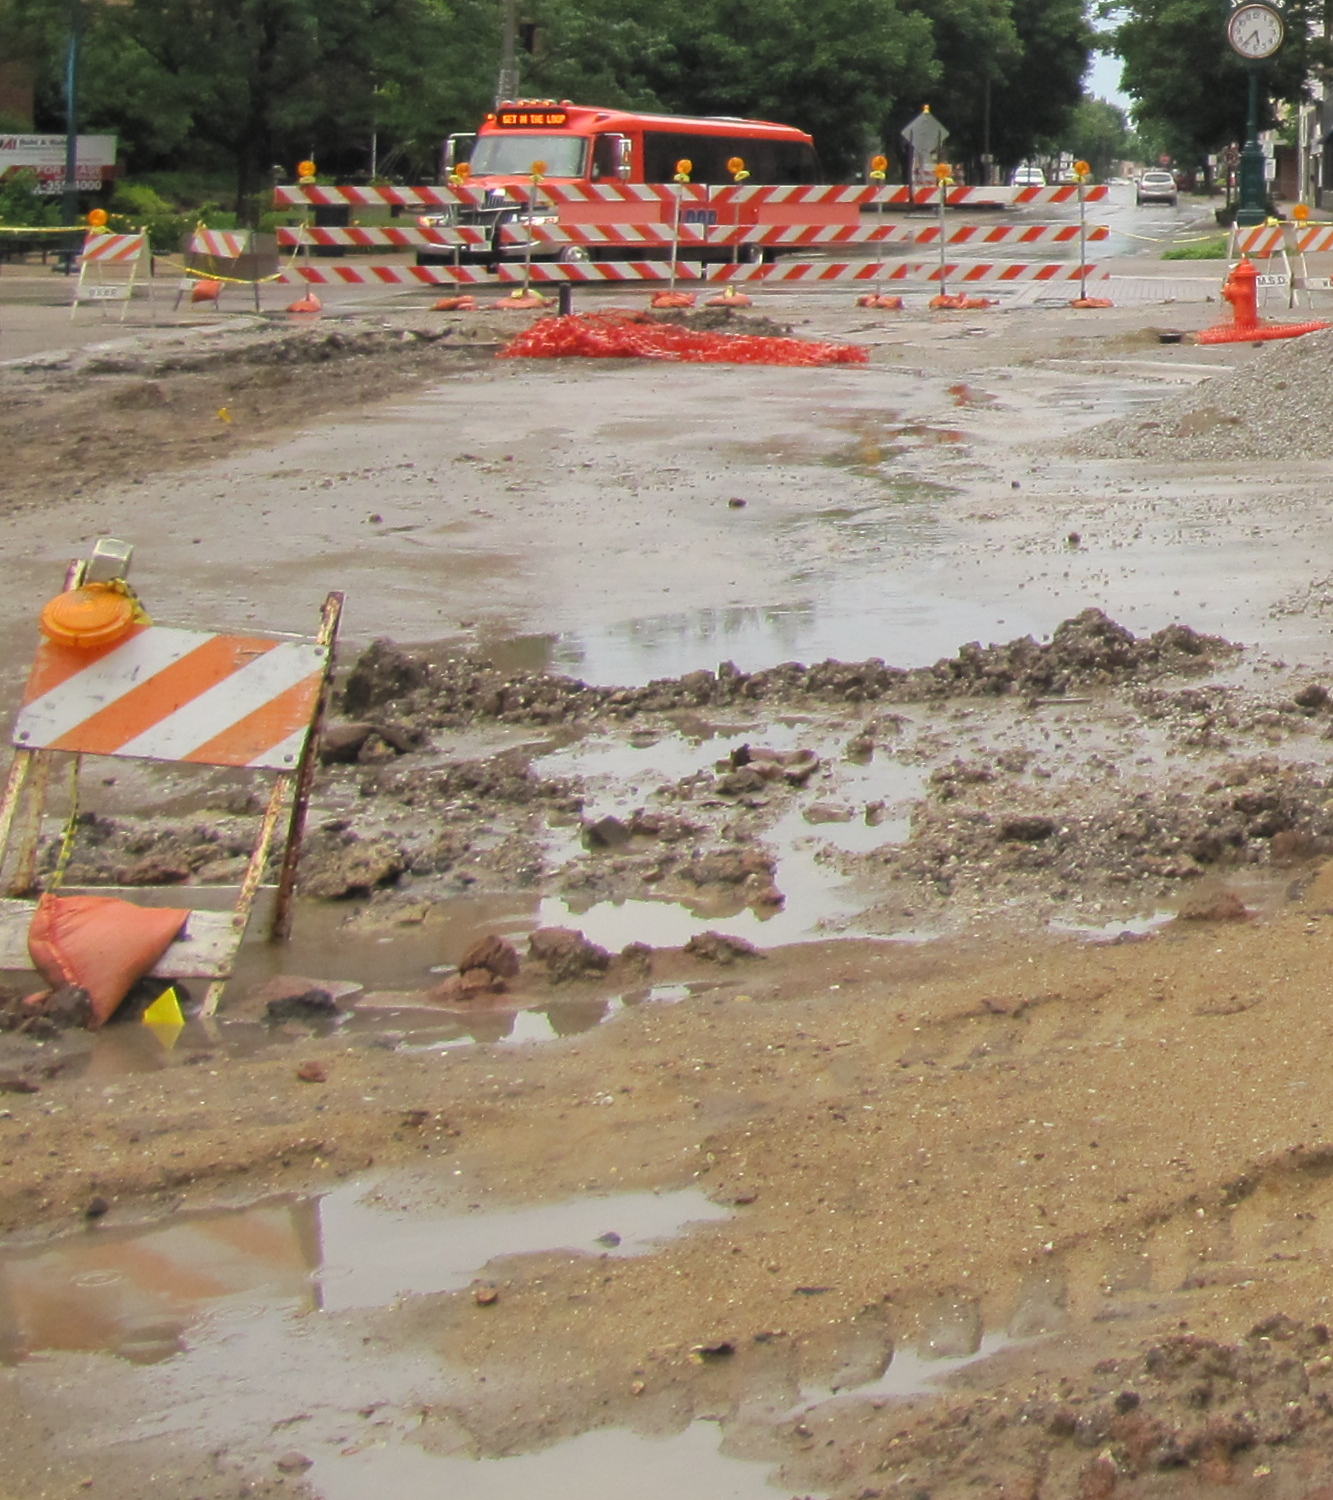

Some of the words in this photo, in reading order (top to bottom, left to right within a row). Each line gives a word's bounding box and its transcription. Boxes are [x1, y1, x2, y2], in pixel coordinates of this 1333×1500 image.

[503, 114, 517, 124] GET
[530, 114, 544, 124] THE
[546, 114, 566, 124] LOOP
